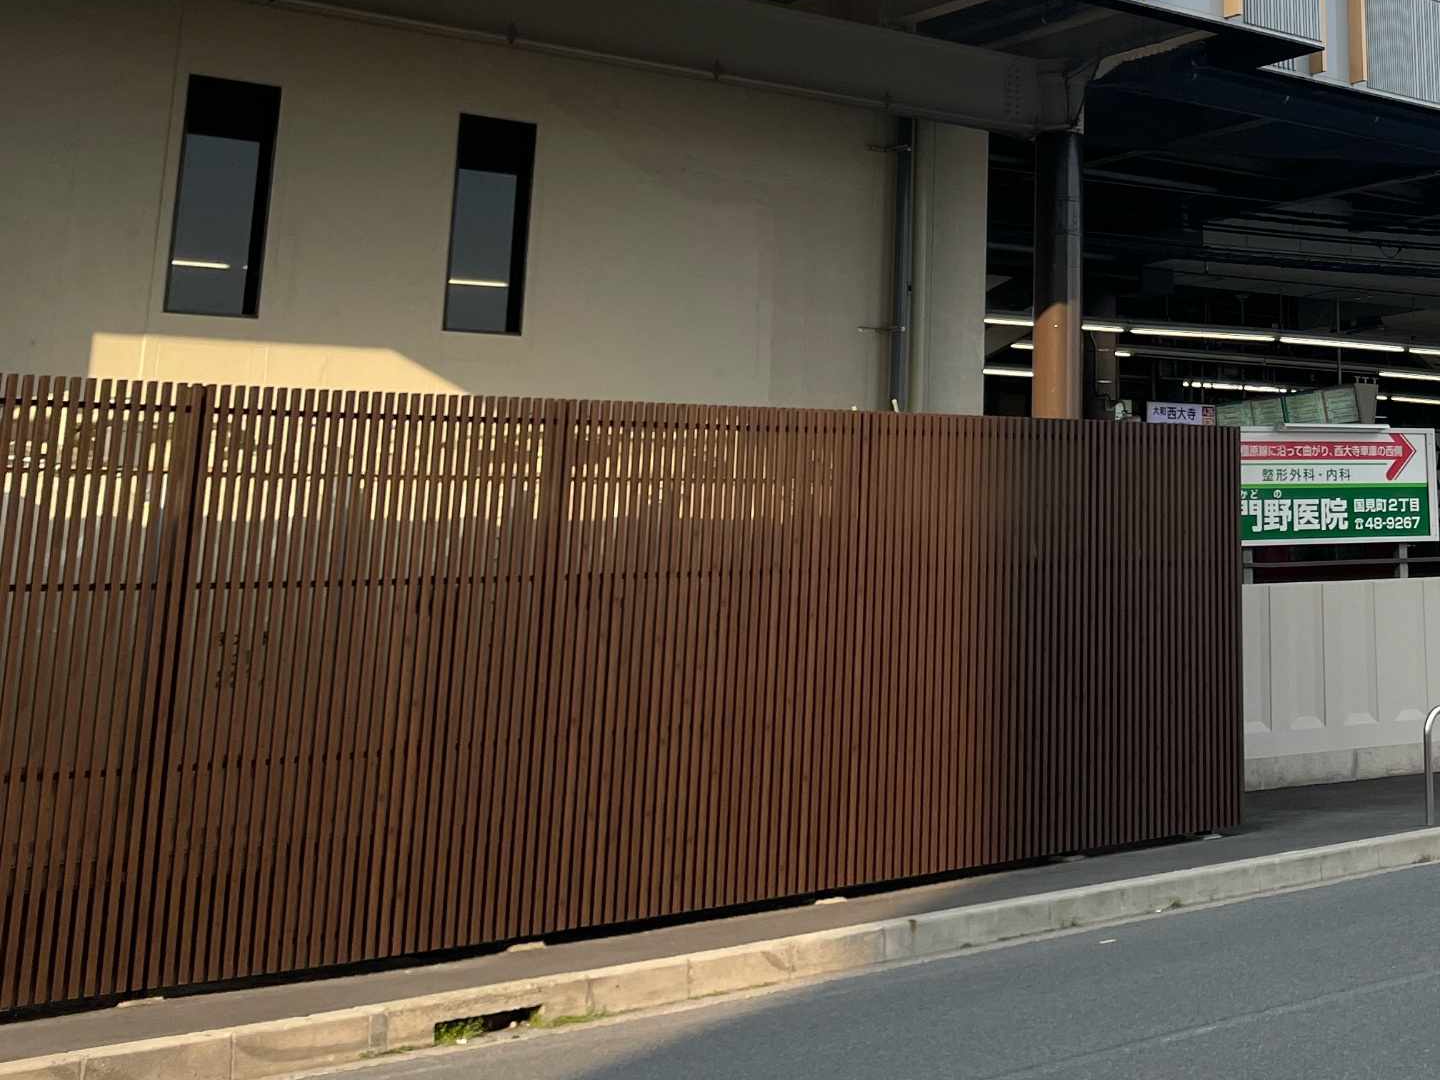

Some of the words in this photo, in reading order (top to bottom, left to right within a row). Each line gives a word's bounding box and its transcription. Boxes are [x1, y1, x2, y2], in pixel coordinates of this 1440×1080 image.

[1261, 468, 1351, 482] 整形外科・内科
[1364, 516, 1421, 530] 48-9267
